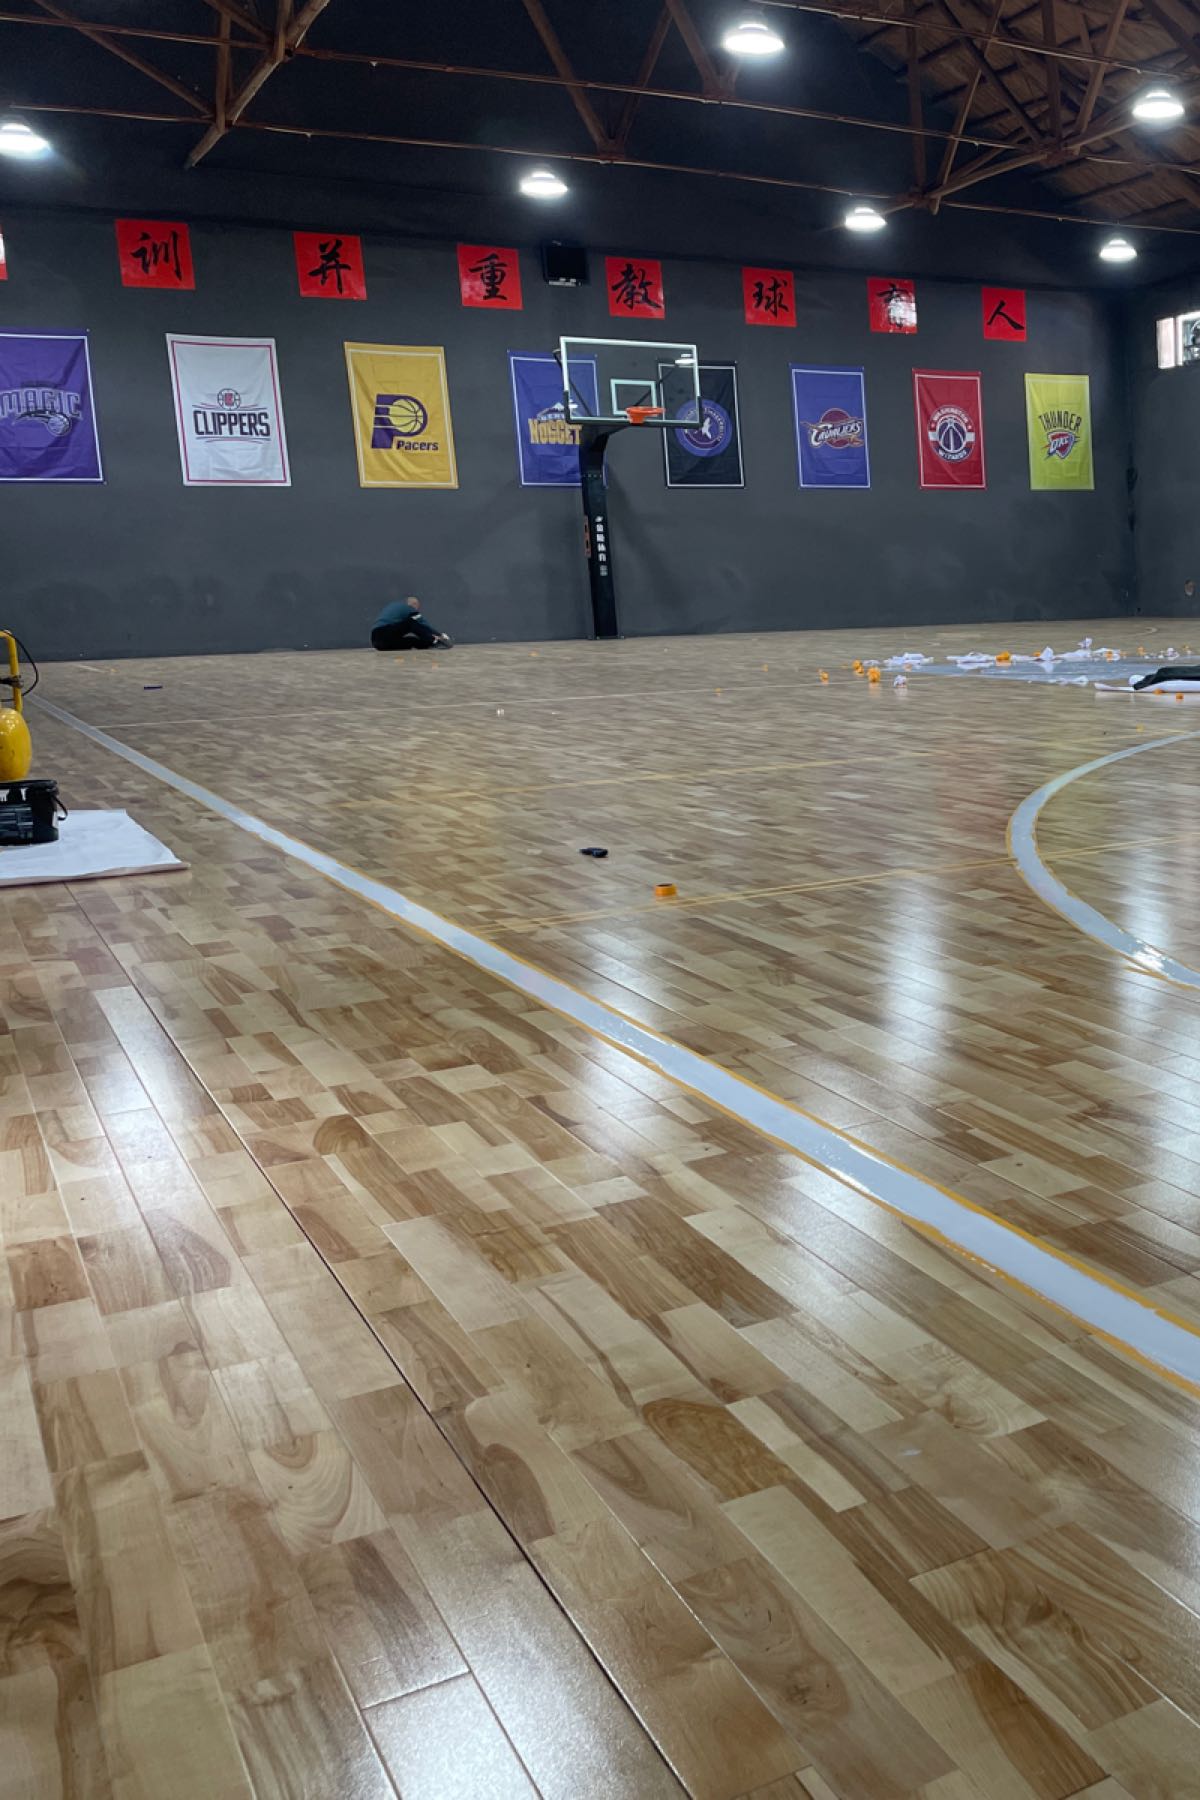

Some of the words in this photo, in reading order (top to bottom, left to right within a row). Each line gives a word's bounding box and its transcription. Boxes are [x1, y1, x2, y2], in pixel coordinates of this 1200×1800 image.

[308, 239, 351, 295] 并
[468, 253, 508, 300] 重
[611, 263, 661, 310] 教
[752, 276, 789, 318] 球
[986, 300, 1025, 330] 人
[193, 410, 271, 437] CLIPPERS
[528, 418, 582, 445] NUGGET
[1038, 410, 1082, 432] THUNDER
[396, 440, 439, 451] Pacers
